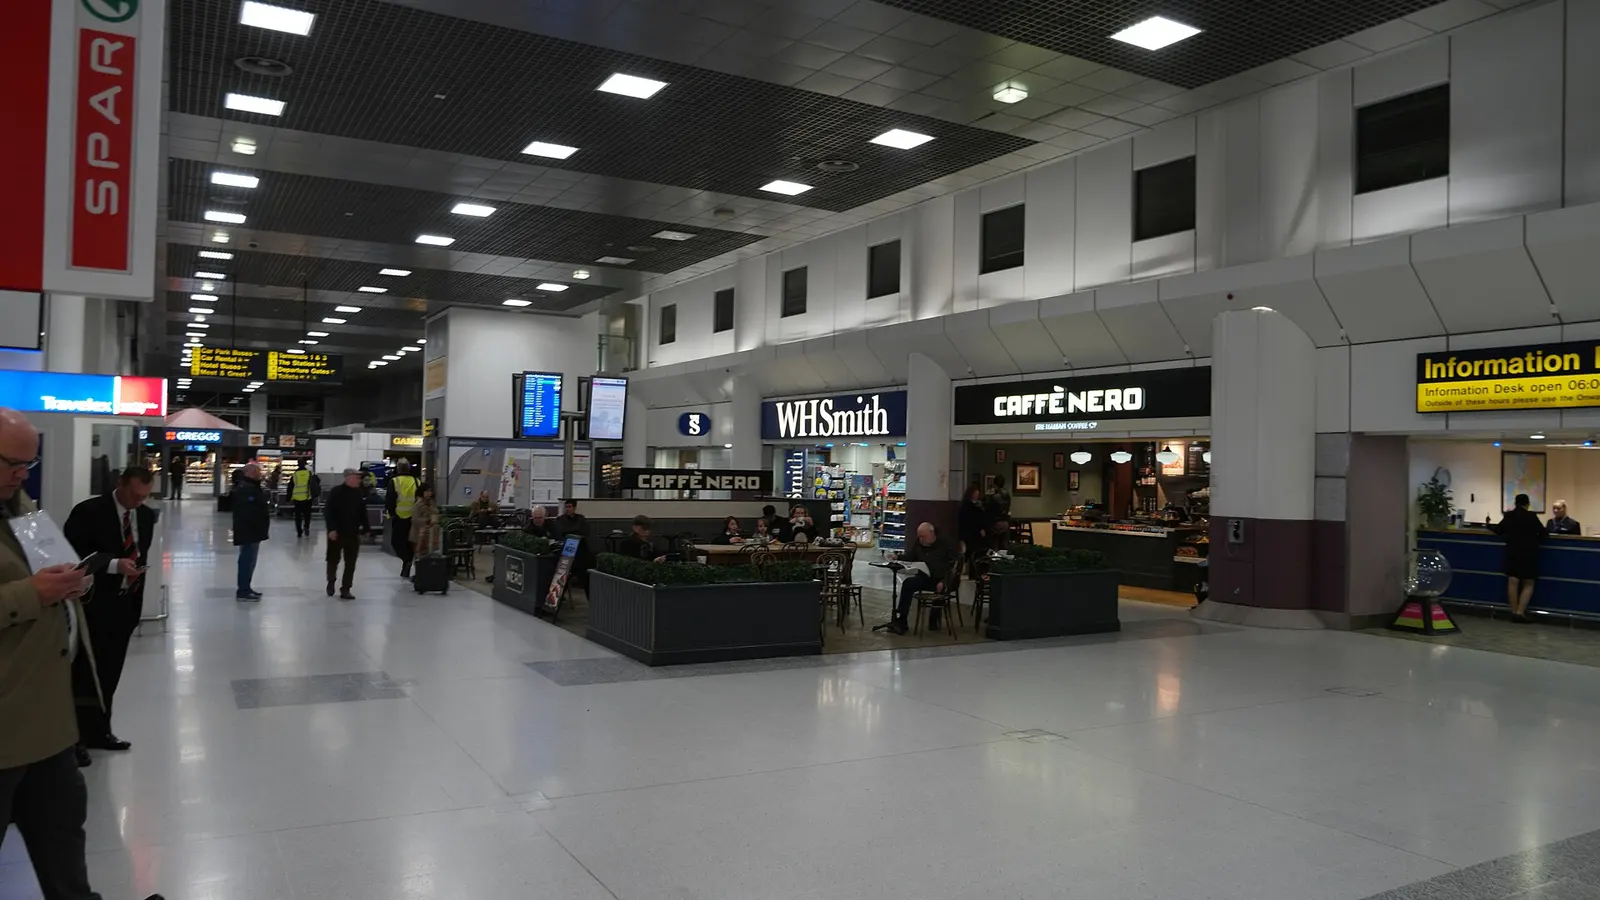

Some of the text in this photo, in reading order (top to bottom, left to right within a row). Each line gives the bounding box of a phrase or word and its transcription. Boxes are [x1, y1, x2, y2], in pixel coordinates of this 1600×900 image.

[85, 37, 125, 216] SPAR
[232, 349, 253, 357] Buses
[278, 352, 309, 360] Terminals
[200, 361, 219, 369] Hotel
[291, 359, 316, 367] Station
[1424, 350, 1580, 379] Information
[277, 366, 330, 375] Departure Gates
[1424, 385, 1489, 397] Information
[1494, 383, 1525, 394] Desk
[1530, 382, 1562, 394] open
[994, 385, 1145, 416] CAFFÈ NERO
[1425, 399, 1452, 407] Outside
[1455, 398, 1463, 406] of
[1465, 398, 1486, 406] these
[1488, 397, 1511, 405] hours
[1512, 396, 1539, 404] please
[1560, 394, 1573, 402] the
[775, 394, 890, 438] WHSmith
[1067, 422, 1088, 430] COFFEE
[176, 431, 220, 441] GREGGS
[637, 471, 761, 490] CAFFÈ NERO
